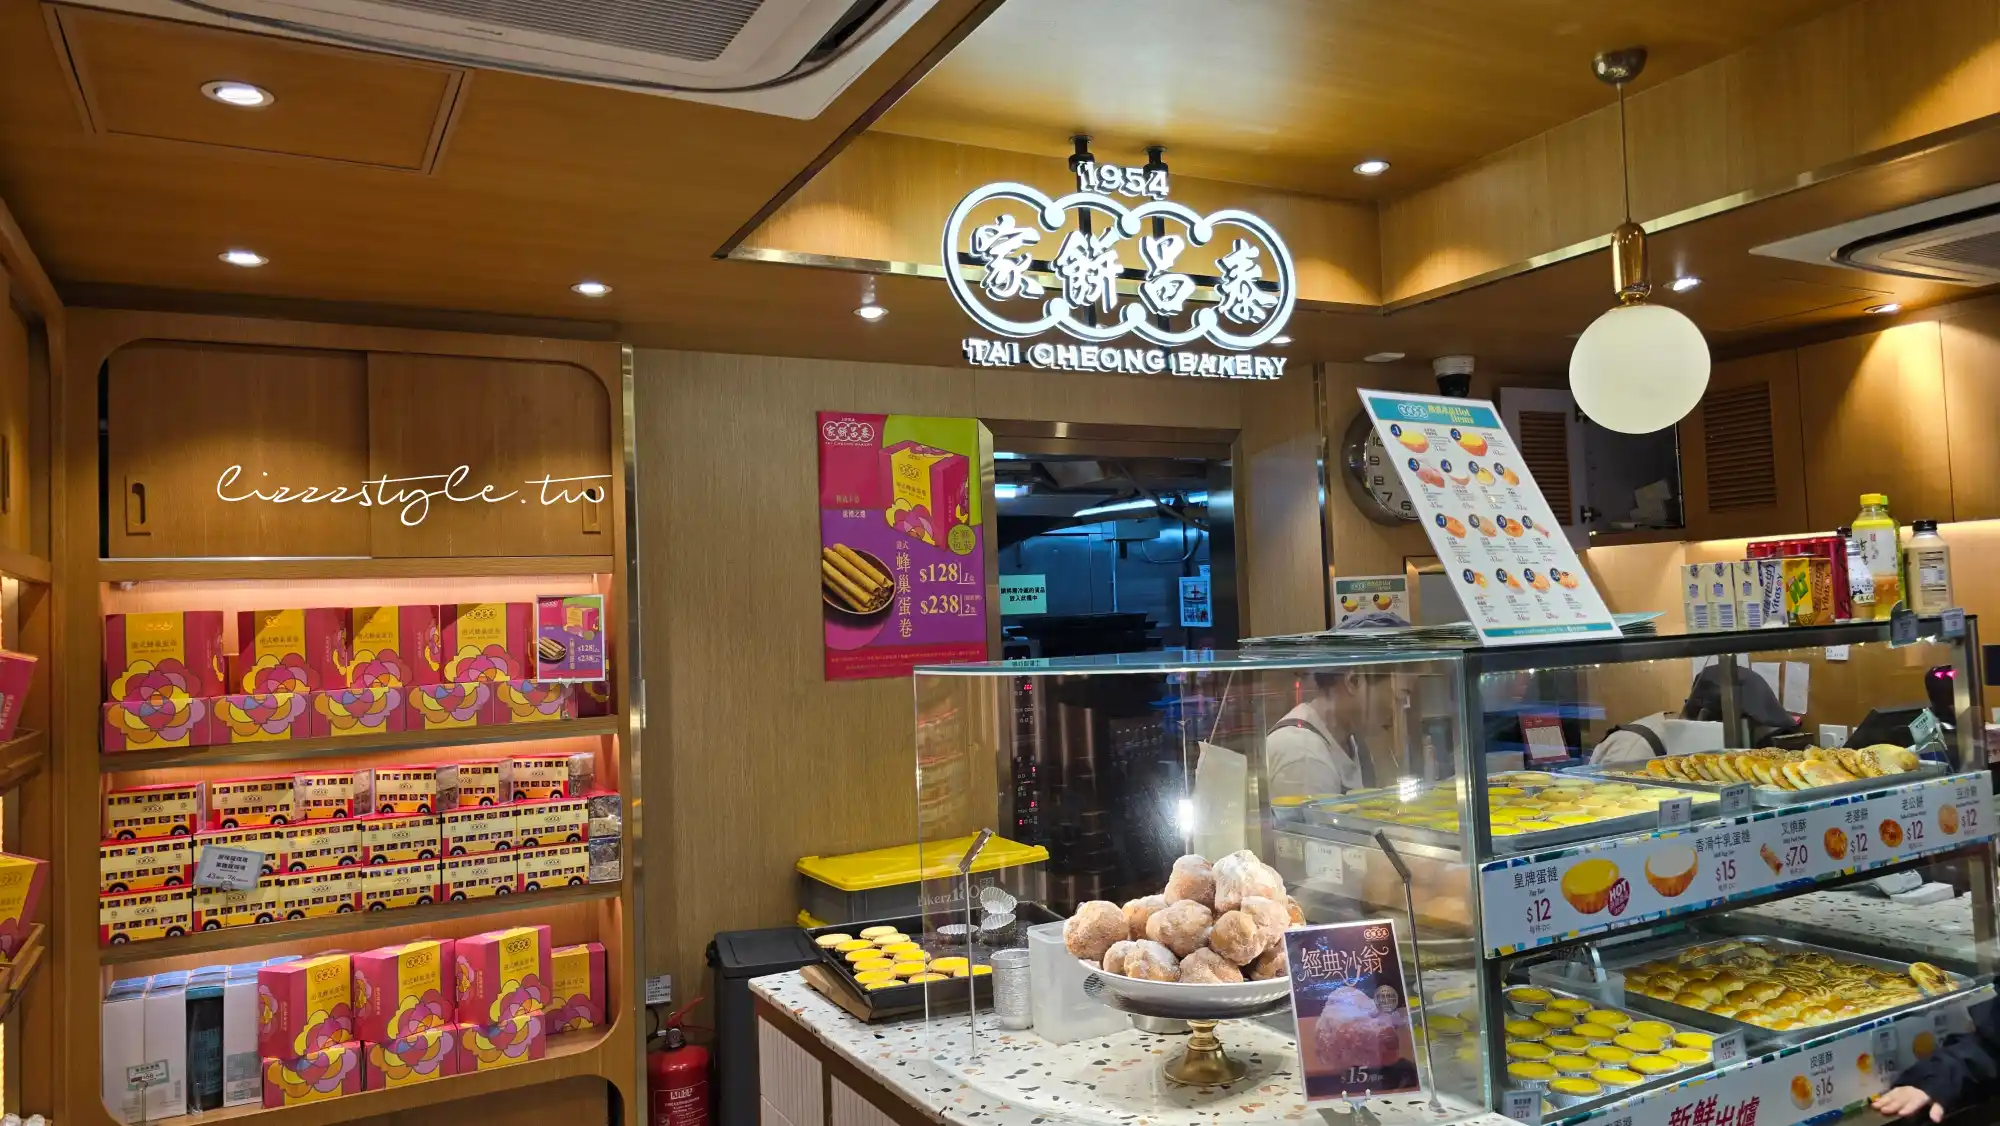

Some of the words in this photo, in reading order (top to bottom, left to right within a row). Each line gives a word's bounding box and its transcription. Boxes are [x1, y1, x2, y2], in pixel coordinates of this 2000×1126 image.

[1078, 161, 1169, 199] 1954
[963, 337, 1021, 366] TAI
[1029, 343, 1166, 373] CHEONG
[1172, 351, 1288, 380] BAKERY
[1369, 456, 1380, 466] 9
[1374, 476, 1384, 485] 8
[1382, 491, 1393, 502] 7
[1401, 501, 1412, 511] 6
[919, 563, 958, 582] $128
[896, 552, 912, 638] 蜂巢蛋卷
[920, 594, 959, 615] $238
[1961, 808, 1977, 827] $12
[1906, 820, 1924, 841] $12
[1850, 833, 1868, 853] $12
[1715, 859, 1736, 882] $15
[1609, 881, 1627, 901] HOT
[1526, 898, 1552, 923] $12
[1298, 944, 1389, 986] 經典沙翁
[1815, 1076, 1834, 1097] $16
